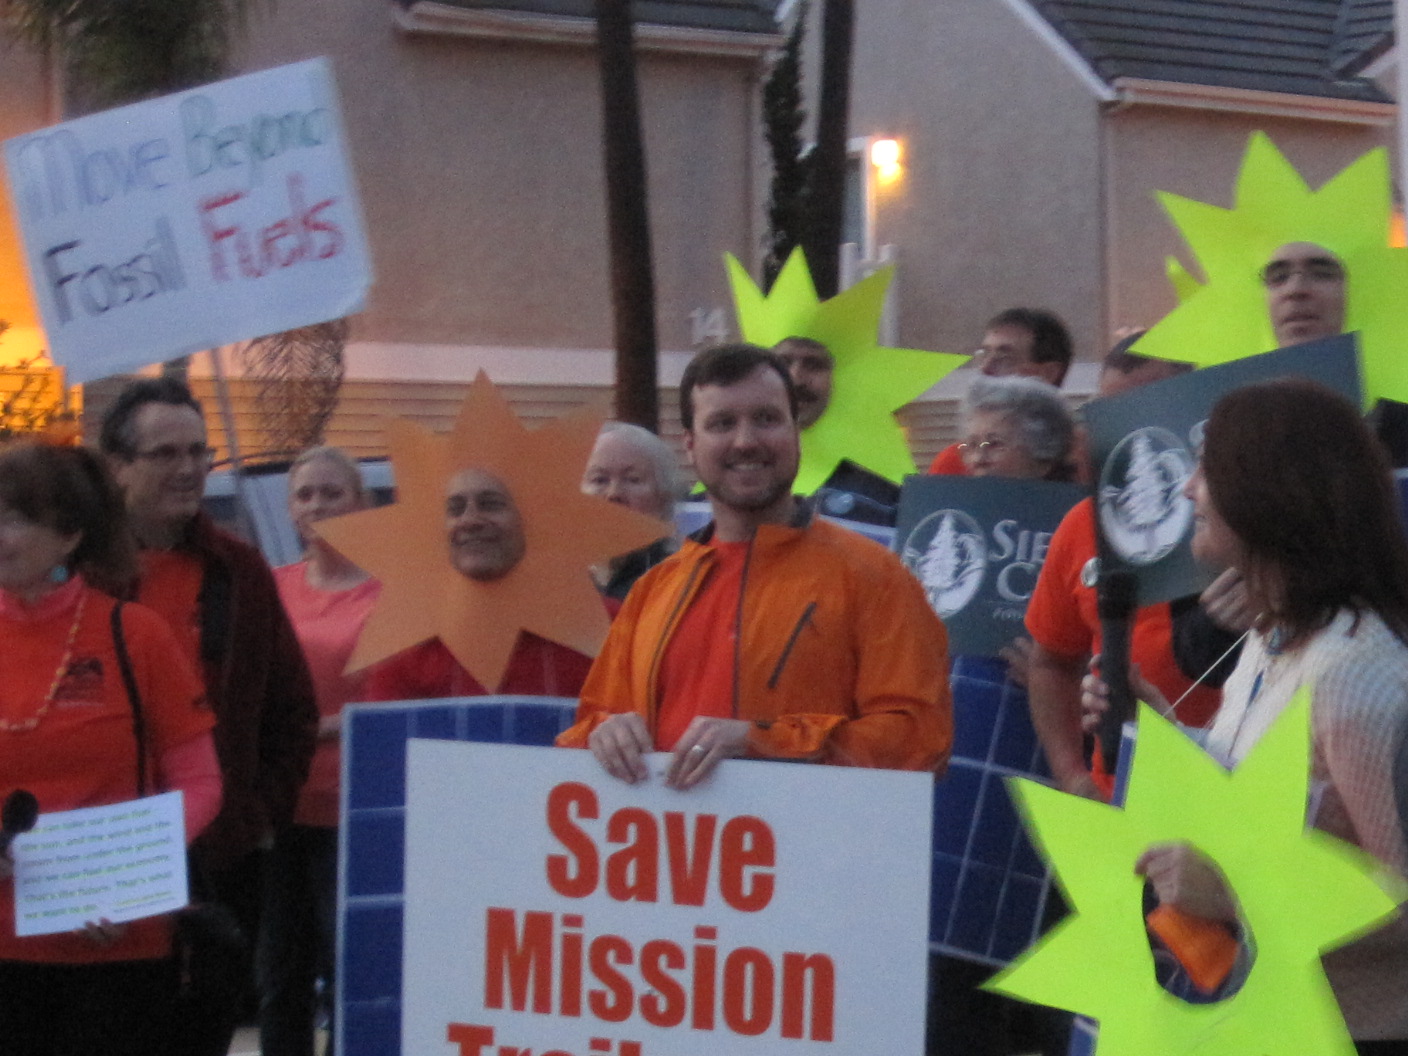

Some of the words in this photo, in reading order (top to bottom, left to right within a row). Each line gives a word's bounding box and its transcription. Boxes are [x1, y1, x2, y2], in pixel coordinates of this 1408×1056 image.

[43, 215, 187, 322] Fossil
[198, 170, 345, 282] Fuels
[546, 781, 776, 913] Save
[484, 906, 835, 1042] Mission
